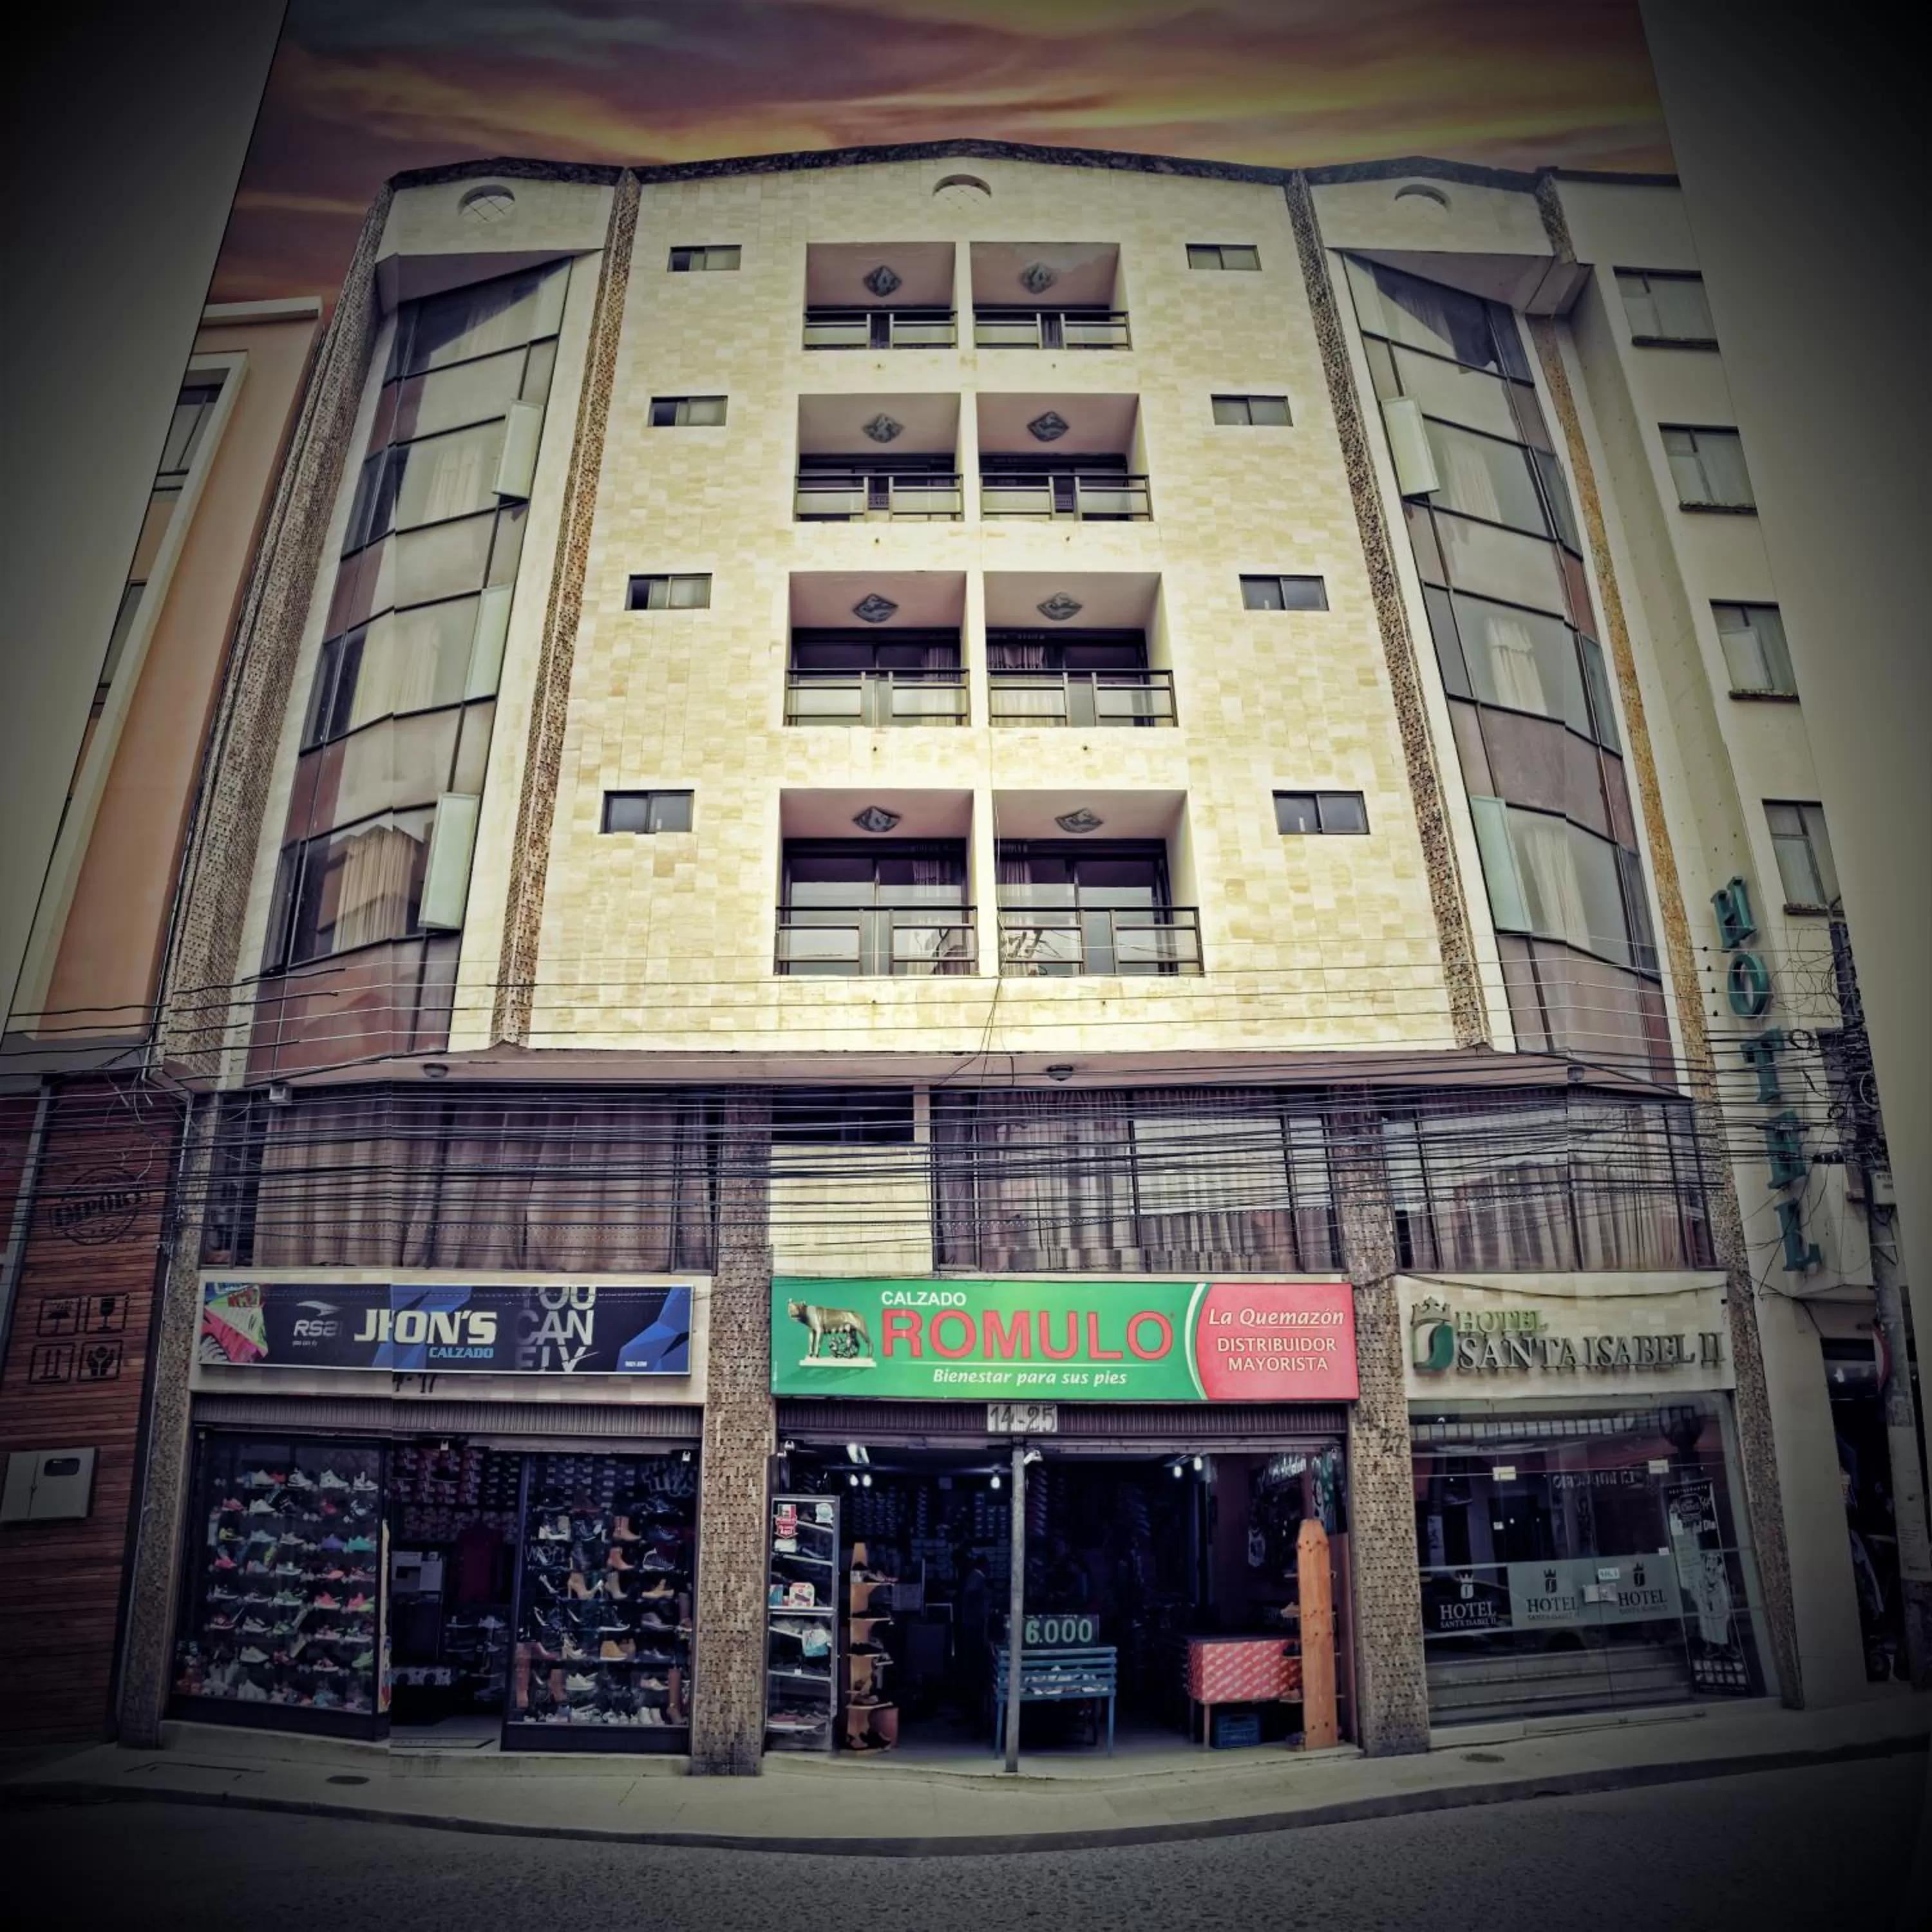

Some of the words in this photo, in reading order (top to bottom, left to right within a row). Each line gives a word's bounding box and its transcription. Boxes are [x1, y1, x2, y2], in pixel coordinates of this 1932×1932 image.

[1710, 876, 1824, 1273] HOTEL
[881, 1291, 967, 1305] CALZADO
[516, 1309, 594, 1345] CAN
[1209, 1309, 1232, 1325] La
[1239, 1309, 1344, 1327] Quemazón
[1455, 1310, 1548, 1334] HOTEL
[881, 1309, 1173, 1361] ROMULO
[429, 1347, 494, 1358] CALZADO
[1217, 1338, 1336, 1352] DISTRIBUIDOR
[1457, 1336, 1576, 1370] SANTA
[1584, 1333, 1696, 1368] ISABEL
[1228, 1357, 1329, 1371] MAYORISTA
[933, 1369, 1011, 1384] Bienestar
[1016, 1372, 1056, 1385] para
[1061, 1372, 1089, 1384] sus
[1094, 1370, 1128, 1387] pies
[990, 1406, 1055, 1432] 14-25
[1526, 1597, 1578, 1613] HOTEL
[1620, 1588, 1667, 1606] HOTEL
[1439, 1601, 1496, 1620] HOTEL
[1025, 1619, 1093, 1644] 6.000
